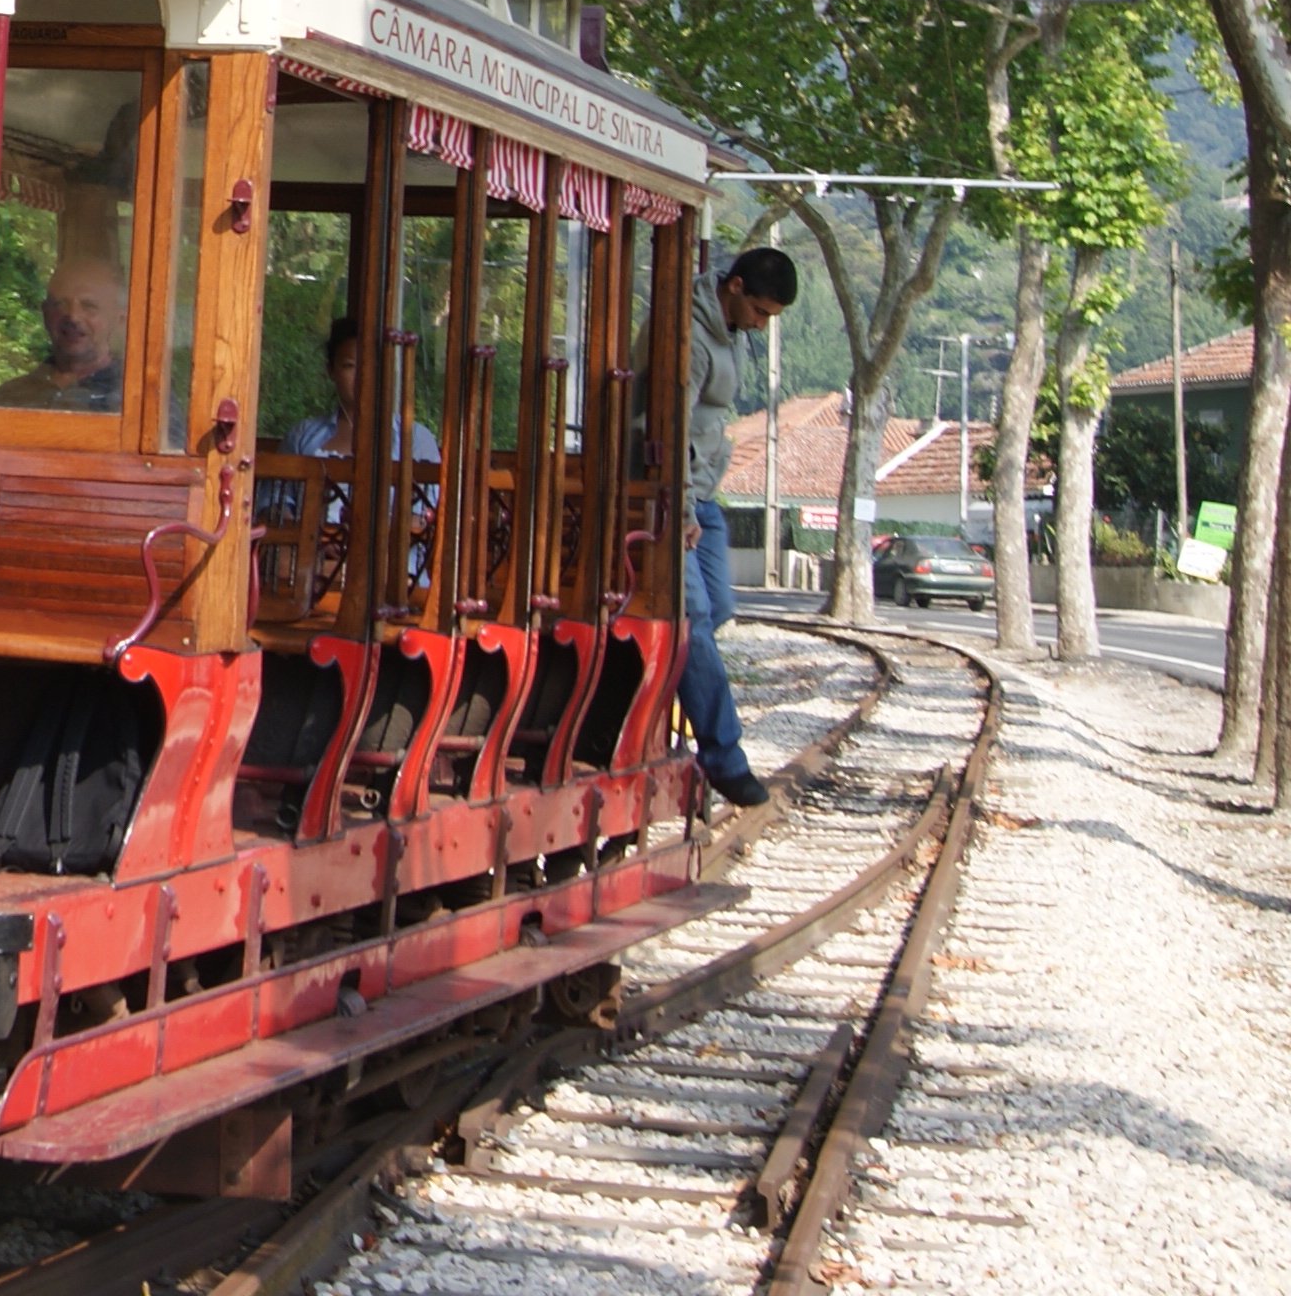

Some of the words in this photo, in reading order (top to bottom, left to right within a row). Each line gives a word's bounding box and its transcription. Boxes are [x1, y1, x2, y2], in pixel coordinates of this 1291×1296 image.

[369, 7, 474, 79] CÂMARA
[480, 55, 581, 125] MUNICIPAL
[587, 102, 606, 136] DE
[610, 111, 664, 158] SINTRA
